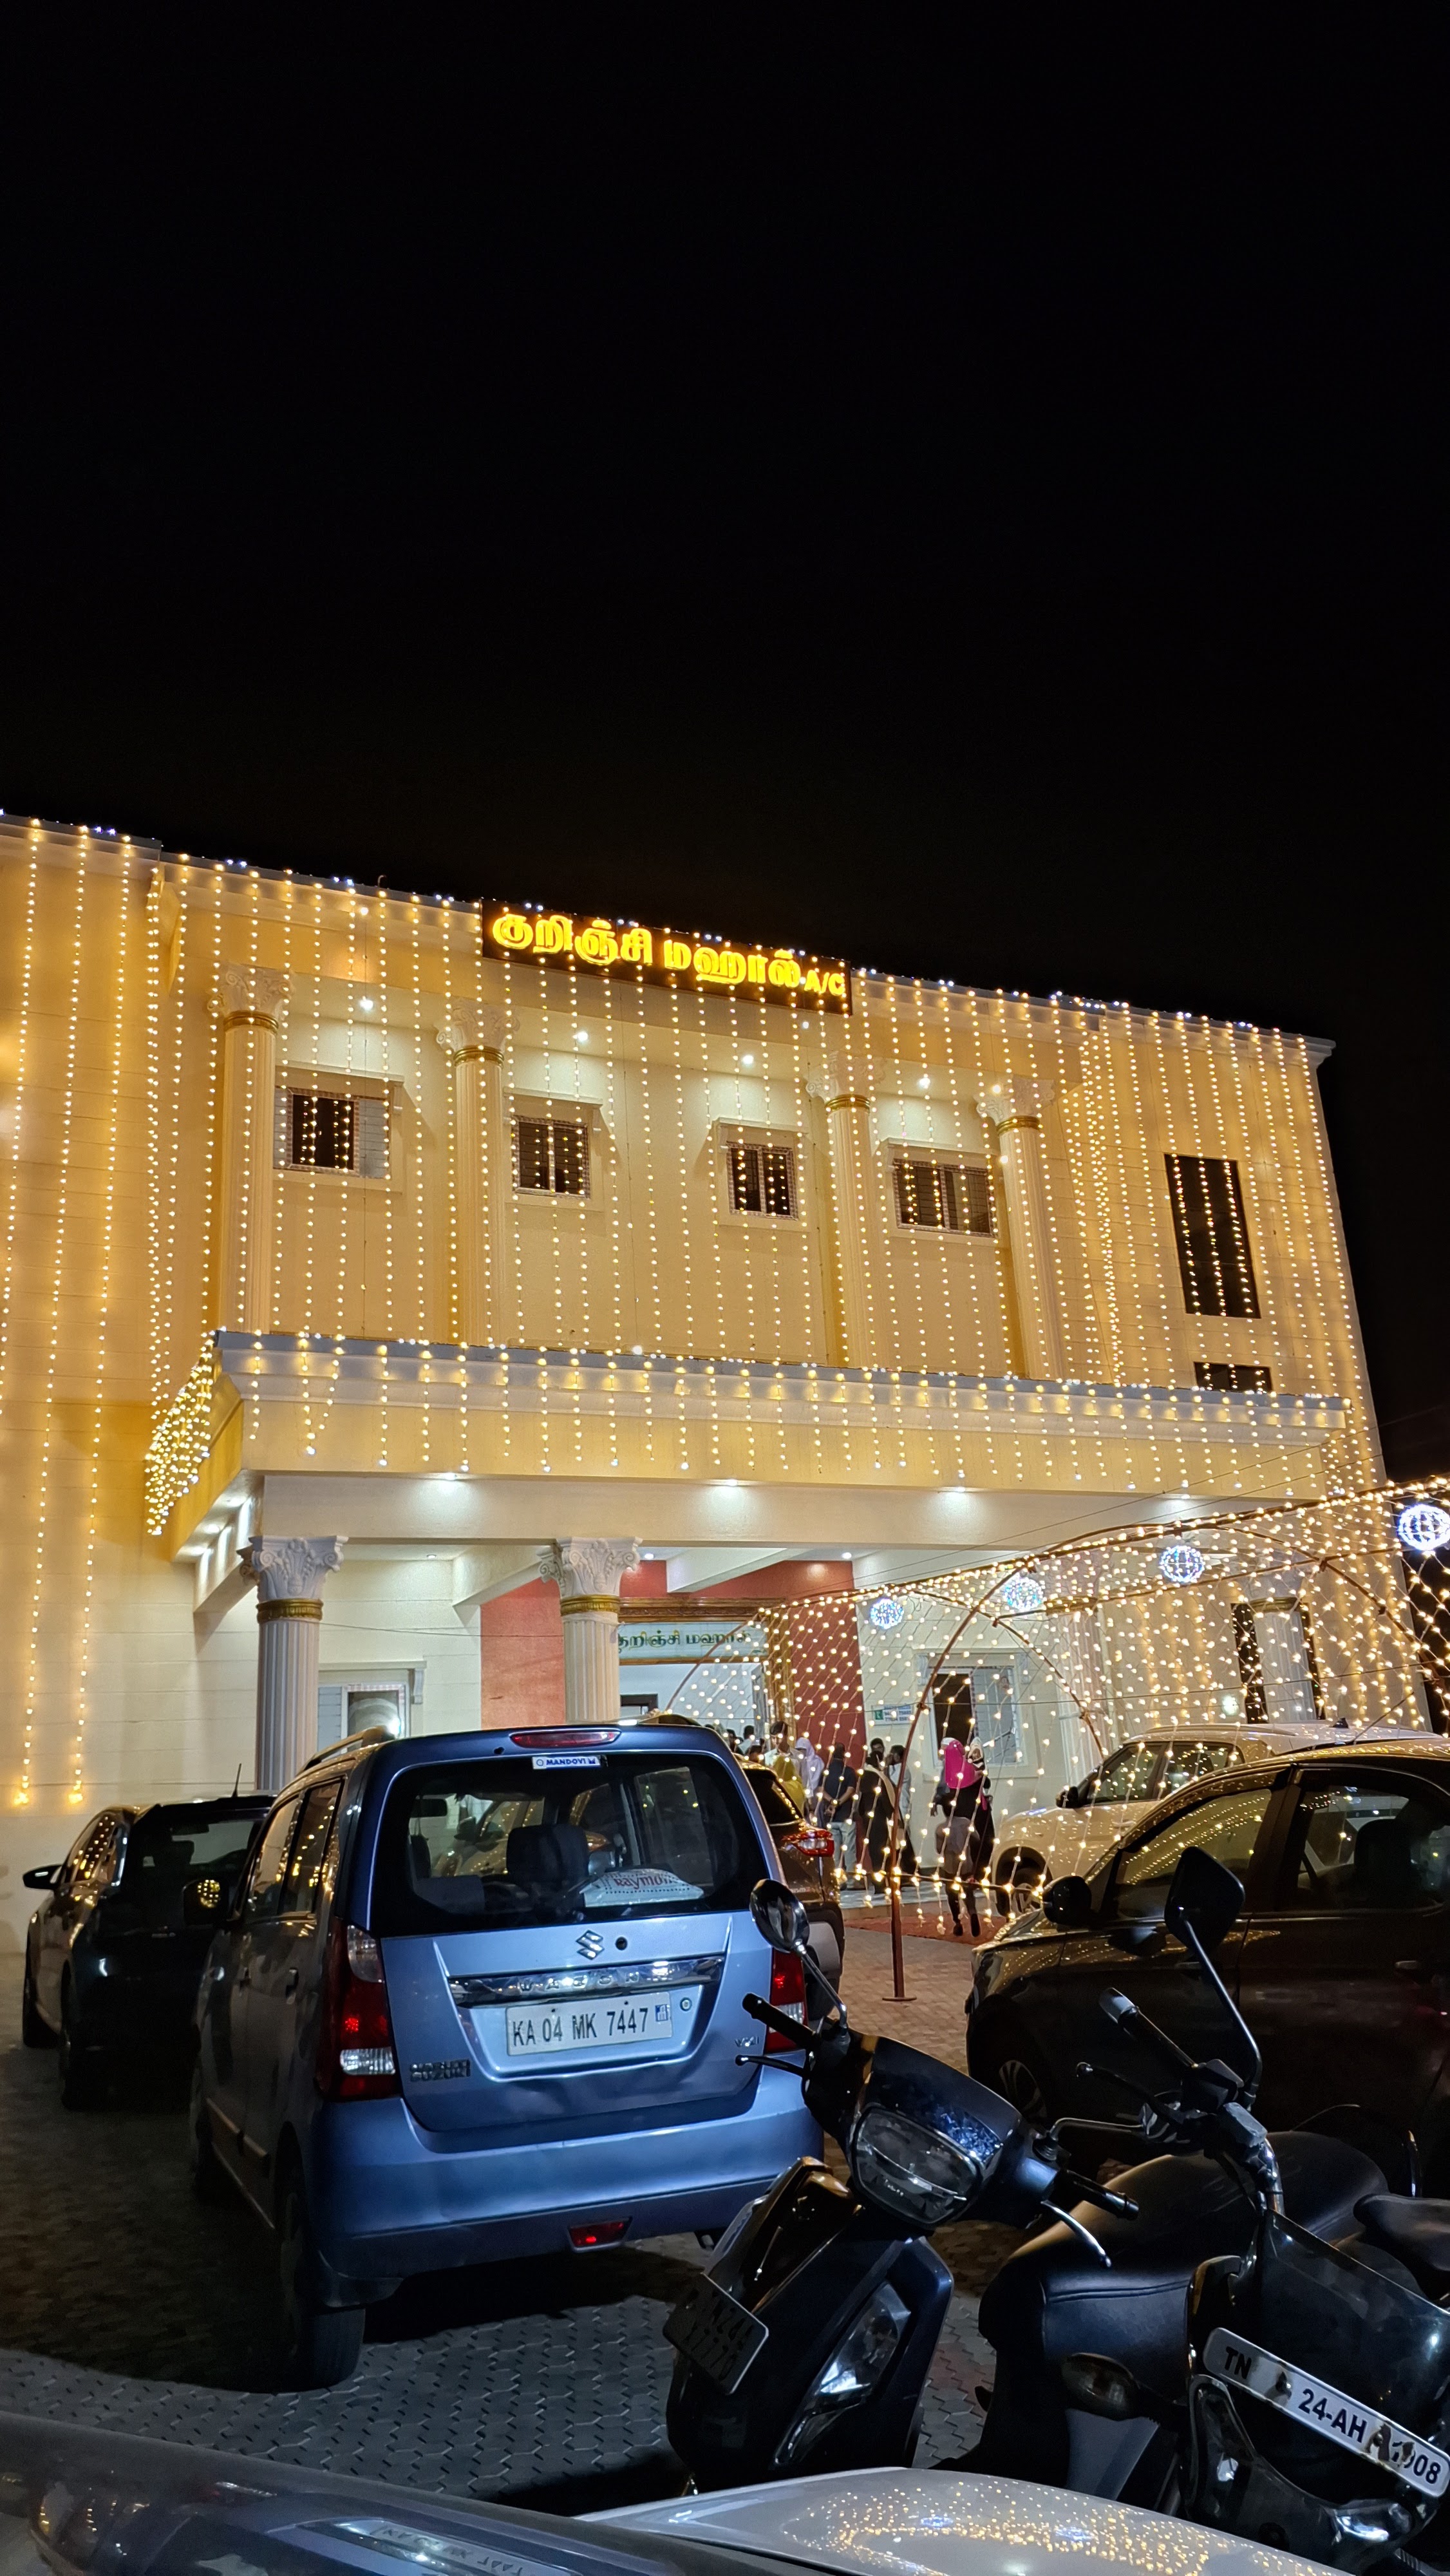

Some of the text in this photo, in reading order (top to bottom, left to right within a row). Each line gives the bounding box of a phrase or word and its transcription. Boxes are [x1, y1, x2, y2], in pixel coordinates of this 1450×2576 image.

[492, 913, 801, 988] குறிஞ்சி மஹால்
[804, 969, 846, 996] A/C
[513, 2007, 648, 2047] KA 04 MK 7447
[1224, 2346, 1252, 2380] TN
[1298, 2388, 1368, 2443] 24-AH
